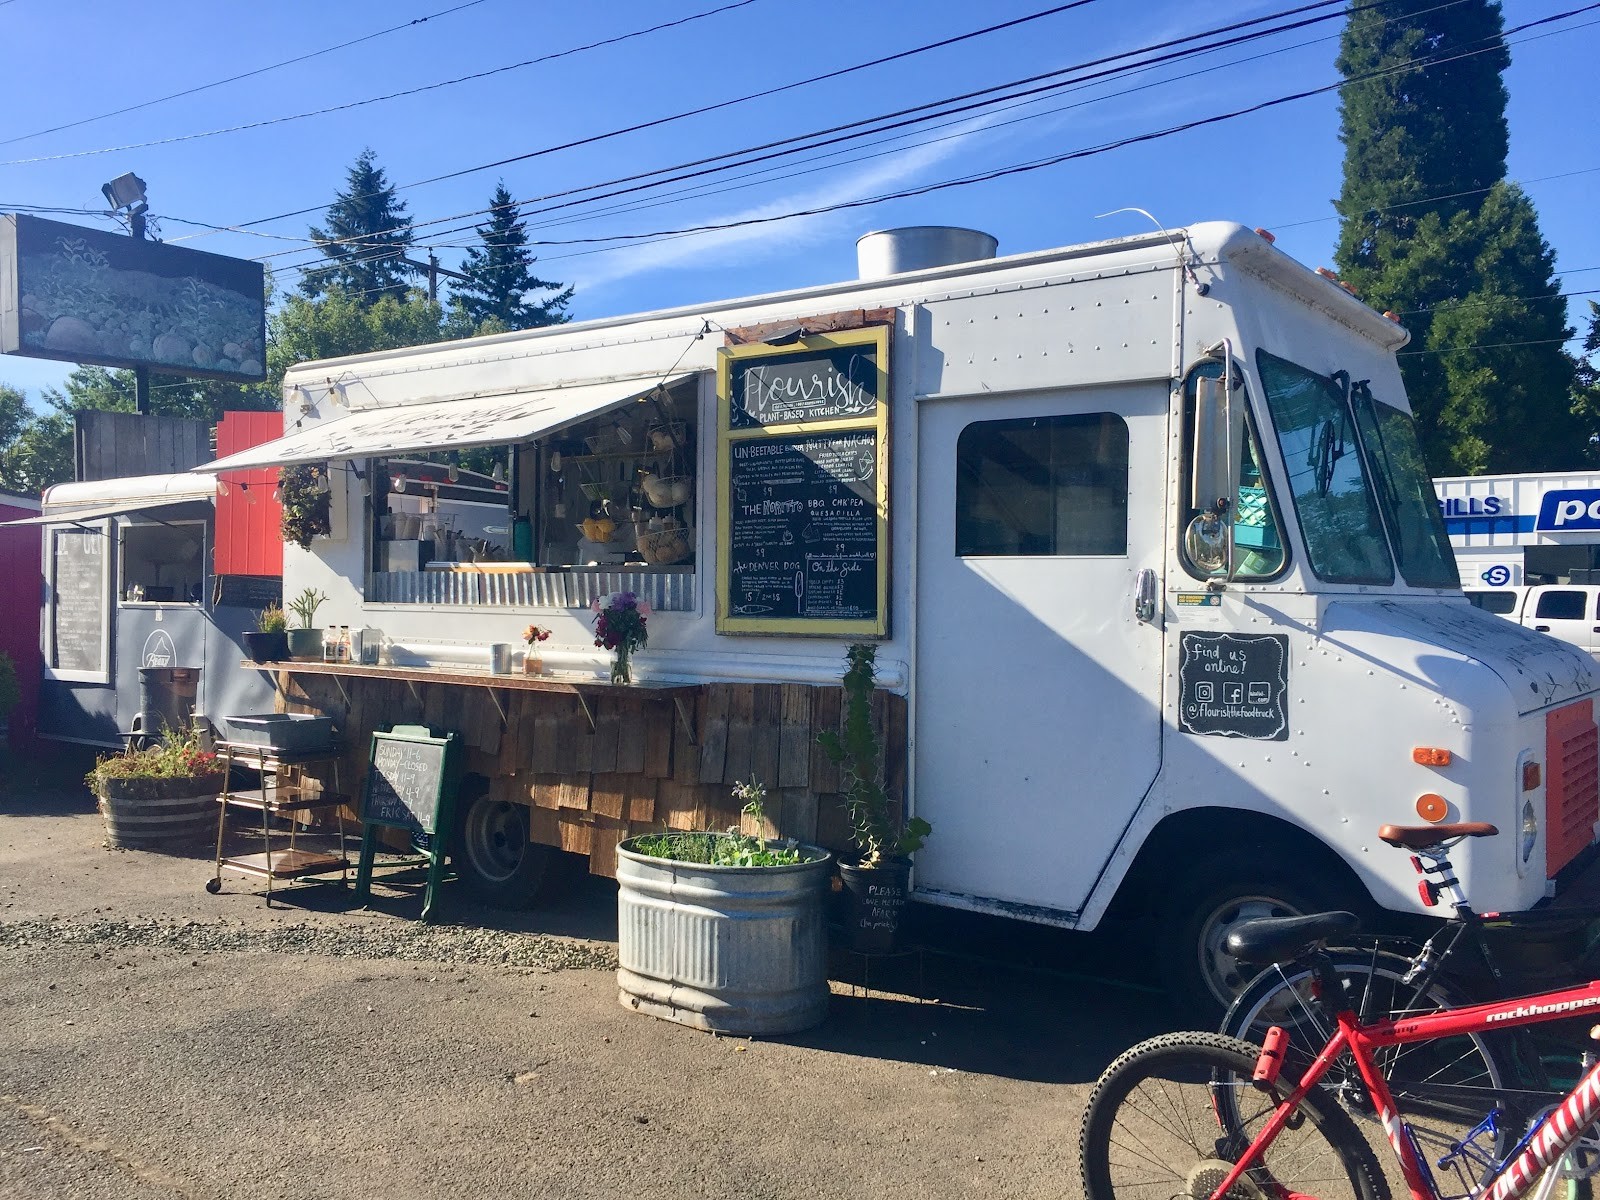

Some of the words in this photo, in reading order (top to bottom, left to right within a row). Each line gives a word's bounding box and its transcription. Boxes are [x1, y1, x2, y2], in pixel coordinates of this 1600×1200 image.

[738, 354, 877, 412] Flourish
[759, 409, 804, 424] PLANT-BASED
[808, 406, 840, 417] KITCHEN
[843, 434, 875, 449] NACHOS
[763, 486, 773, 496] $9
[828, 484, 838, 495] $9
[741, 503, 762, 516] THE
[808, 499, 825, 508] BBQ
[835, 543, 845, 552] $9
[749, 561, 780, 571] DENVER
[783, 561, 800, 571] DOG
[826, 559, 839, 573] the
[840, 562, 862, 578] Side
[1191, 643, 1220, 661] find
[1229, 649, 1247, 662] us
[1204, 660, 1247, 674] online!
[1186, 702, 1275, 719] @flourishthefoodtruck
[868, 885, 901, 896] PLEASE
[1485, 996, 1600, 1023] rockhoppe
